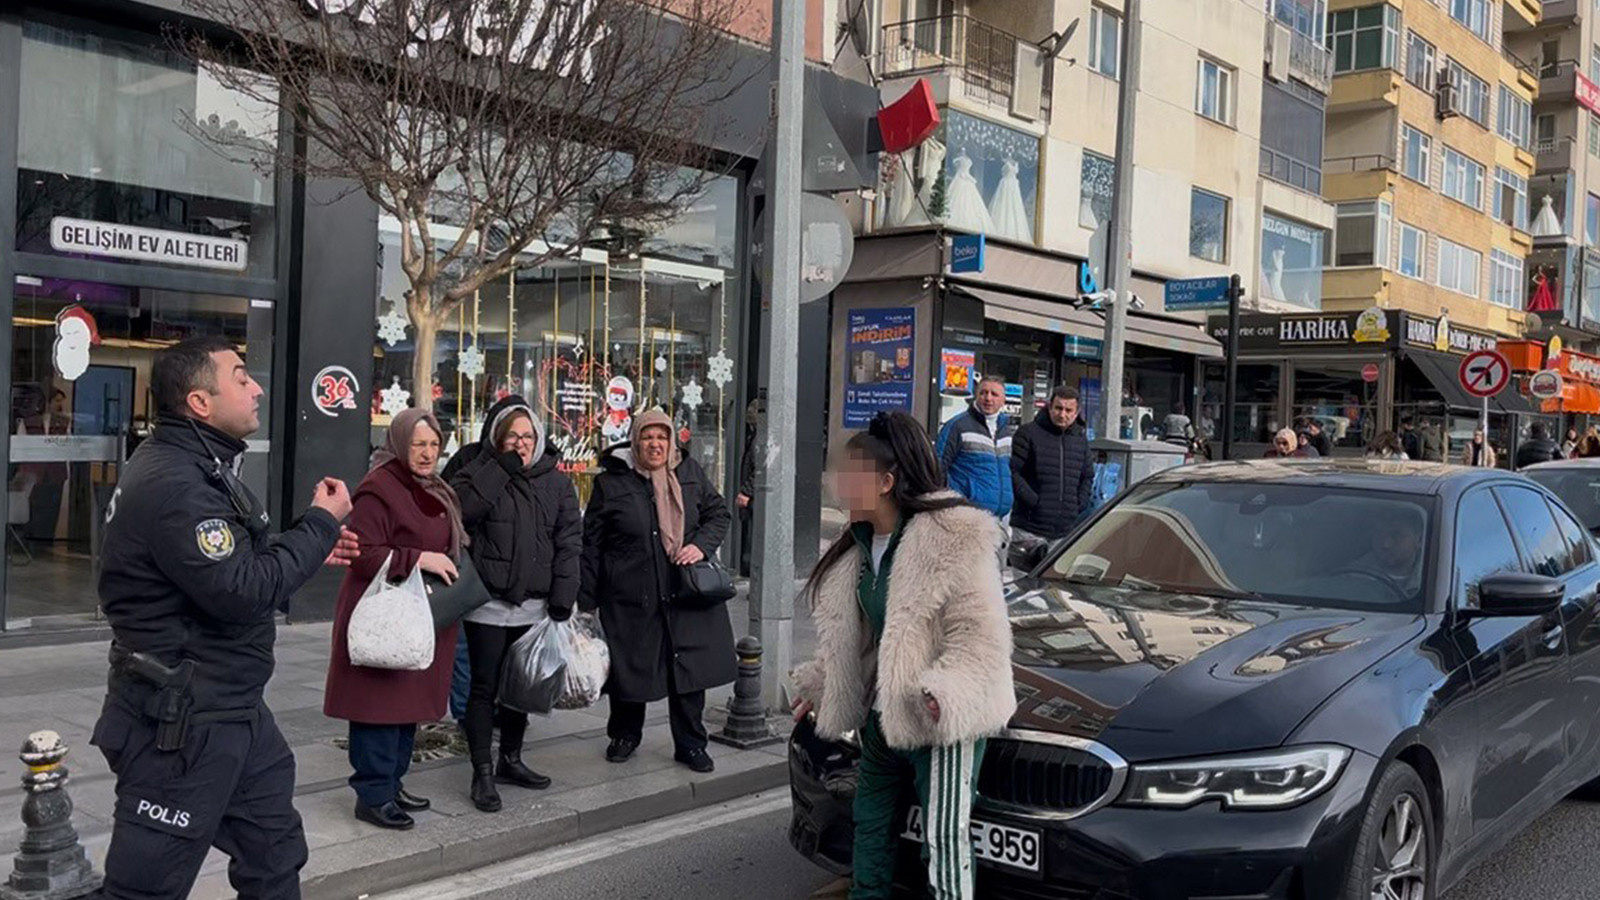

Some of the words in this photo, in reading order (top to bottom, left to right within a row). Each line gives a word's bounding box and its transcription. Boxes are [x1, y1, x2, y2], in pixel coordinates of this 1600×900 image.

[62, 225, 133, 251] GELİŞİM
[138, 235, 160, 254] EV
[163, 240, 239, 264] ALETLERİ
[1169, 280, 1217, 292] BOYACILAR
[1279, 317, 1350, 340] HARİKA
[989, 827, 1037, 866] 959
